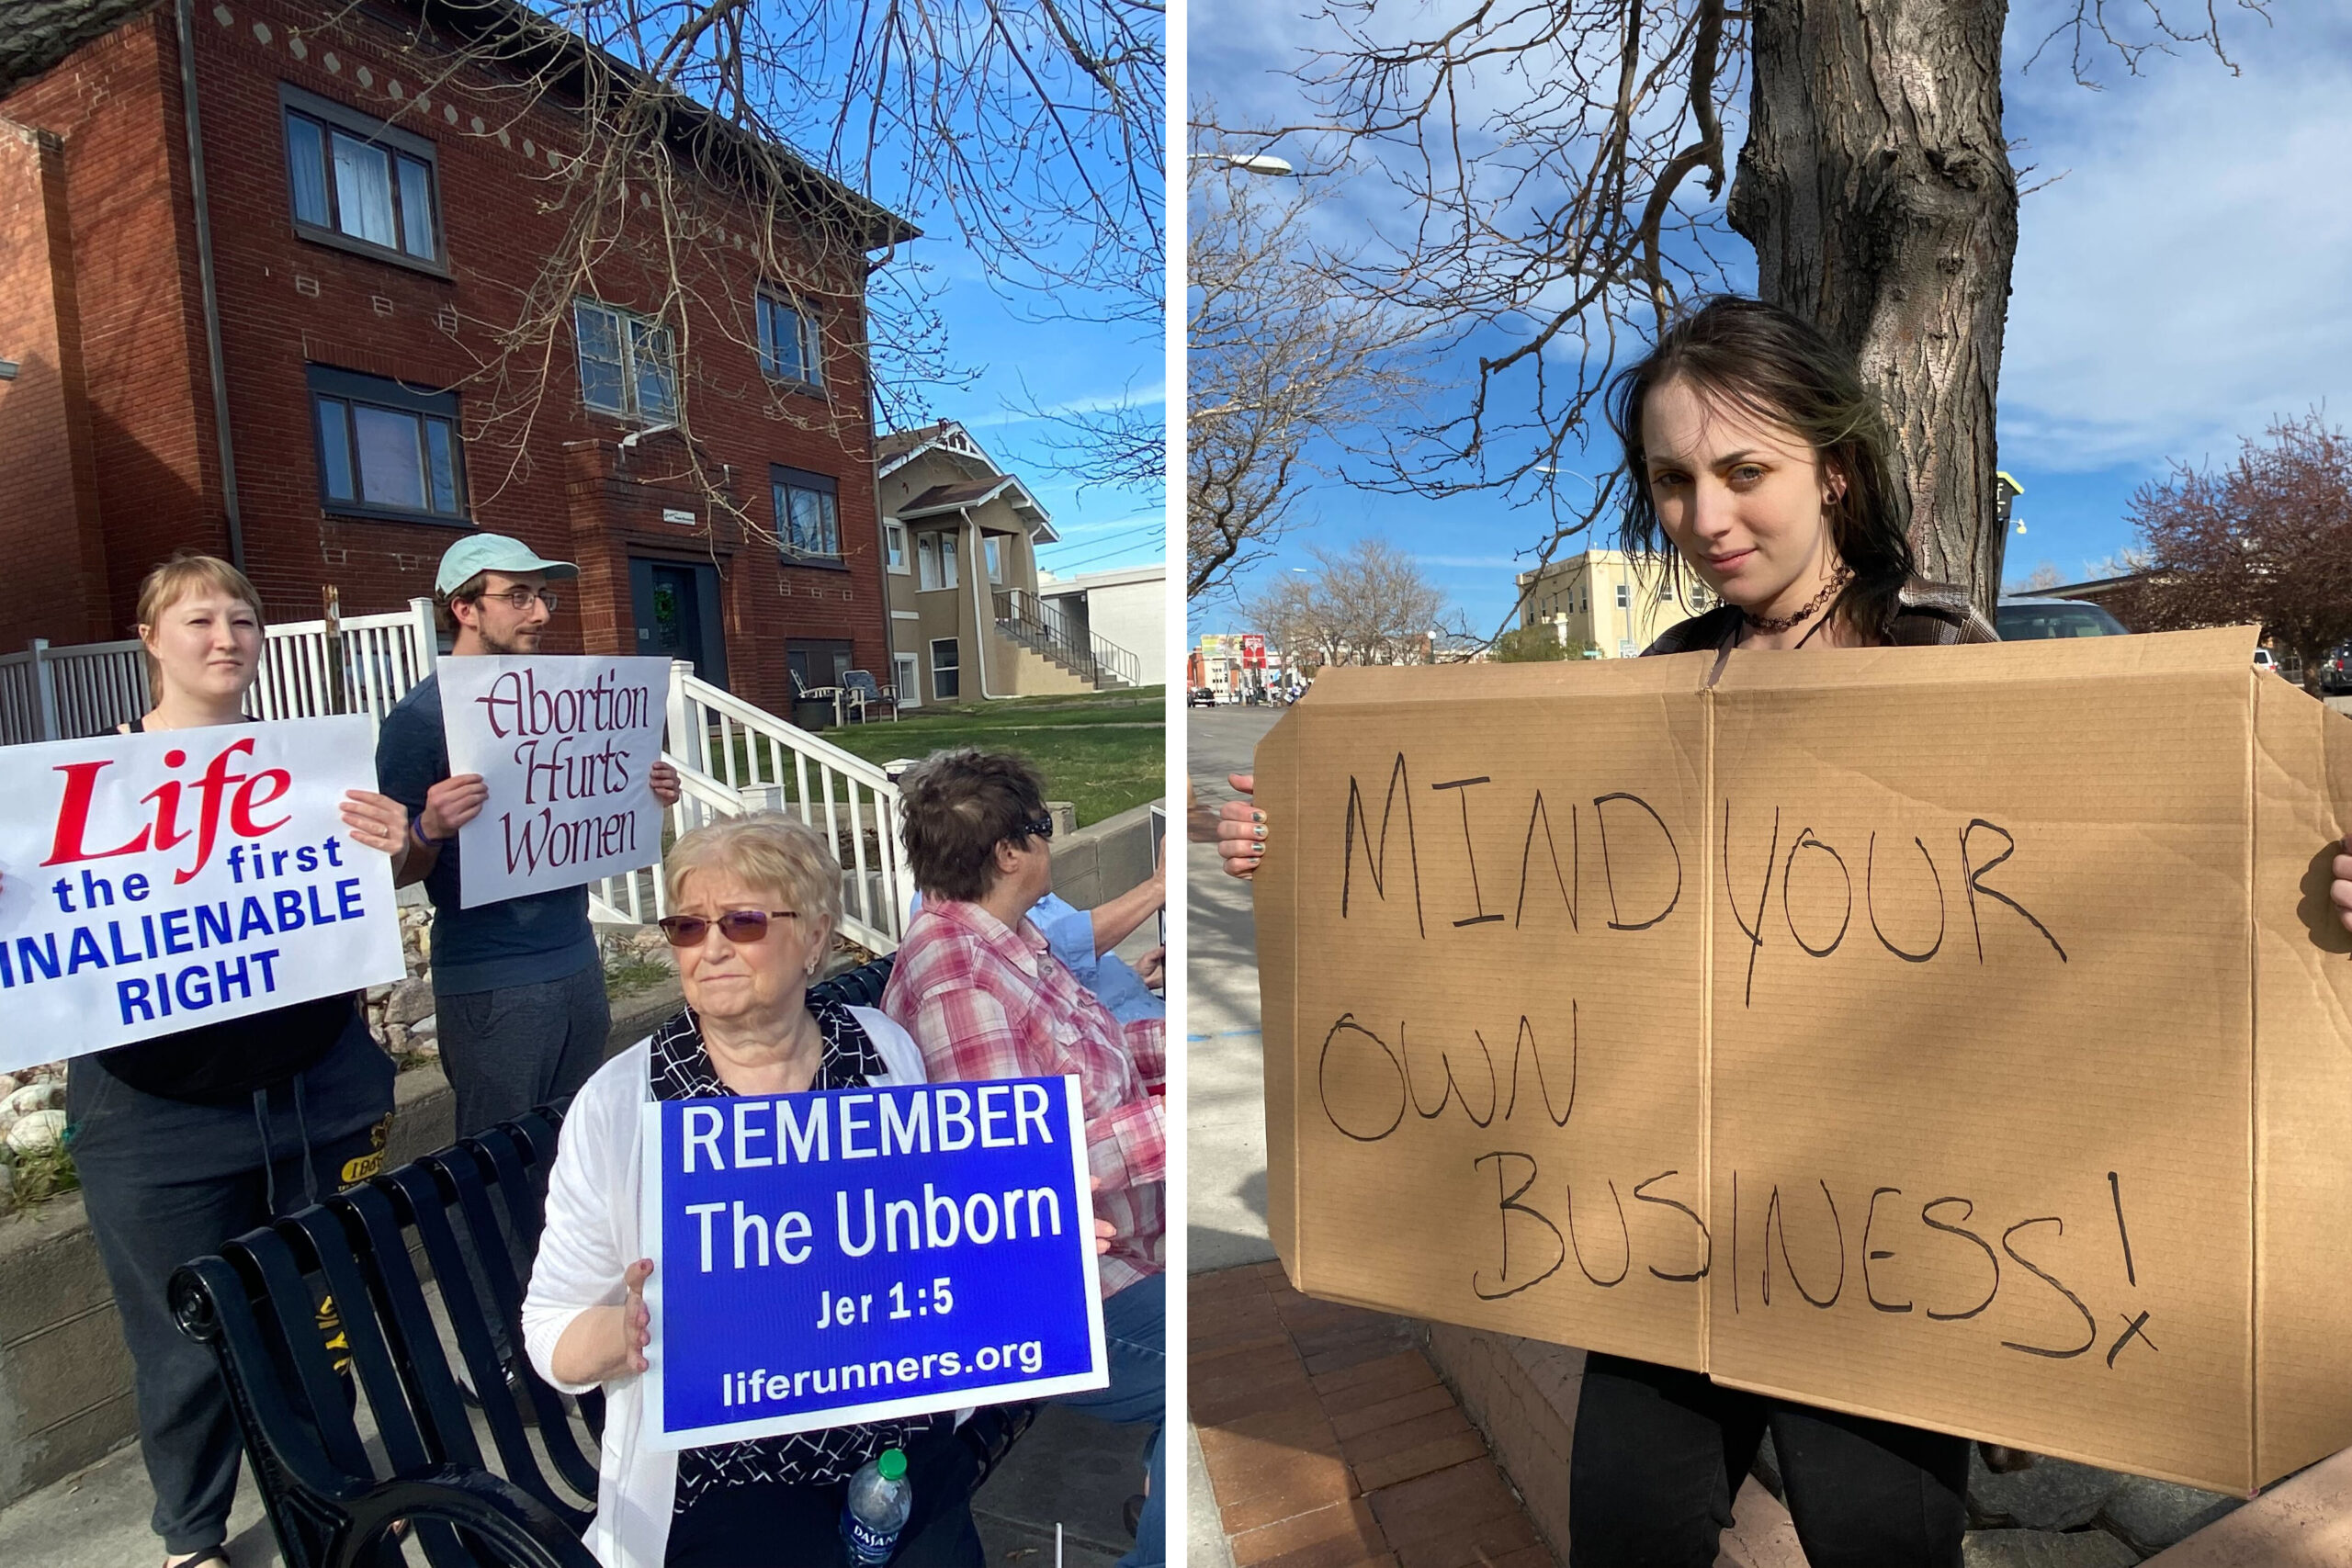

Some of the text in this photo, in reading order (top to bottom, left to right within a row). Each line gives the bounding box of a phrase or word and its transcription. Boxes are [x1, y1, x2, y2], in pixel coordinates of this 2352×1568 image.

[475, 668, 648, 739] Abortion
[514, 736, 630, 805] Hurts
[40, 738, 292, 885] Life
[499, 807, 636, 876] Women
[52, 837, 344, 913] the first
[1342, 751, 2067, 1008] MIND YOUR
[0, 878, 365, 988] INALIENABLE
[118, 950, 280, 1026] RIGHT
[1318, 998, 1578, 1142] OWN
[683, 1083, 1054, 1173] REMEMBER
[685, 1182, 1061, 1273] The Unborn
[817, 1277, 954, 1329] Jer 1:5
[722, 1340, 1044, 1406] liferunners.org
